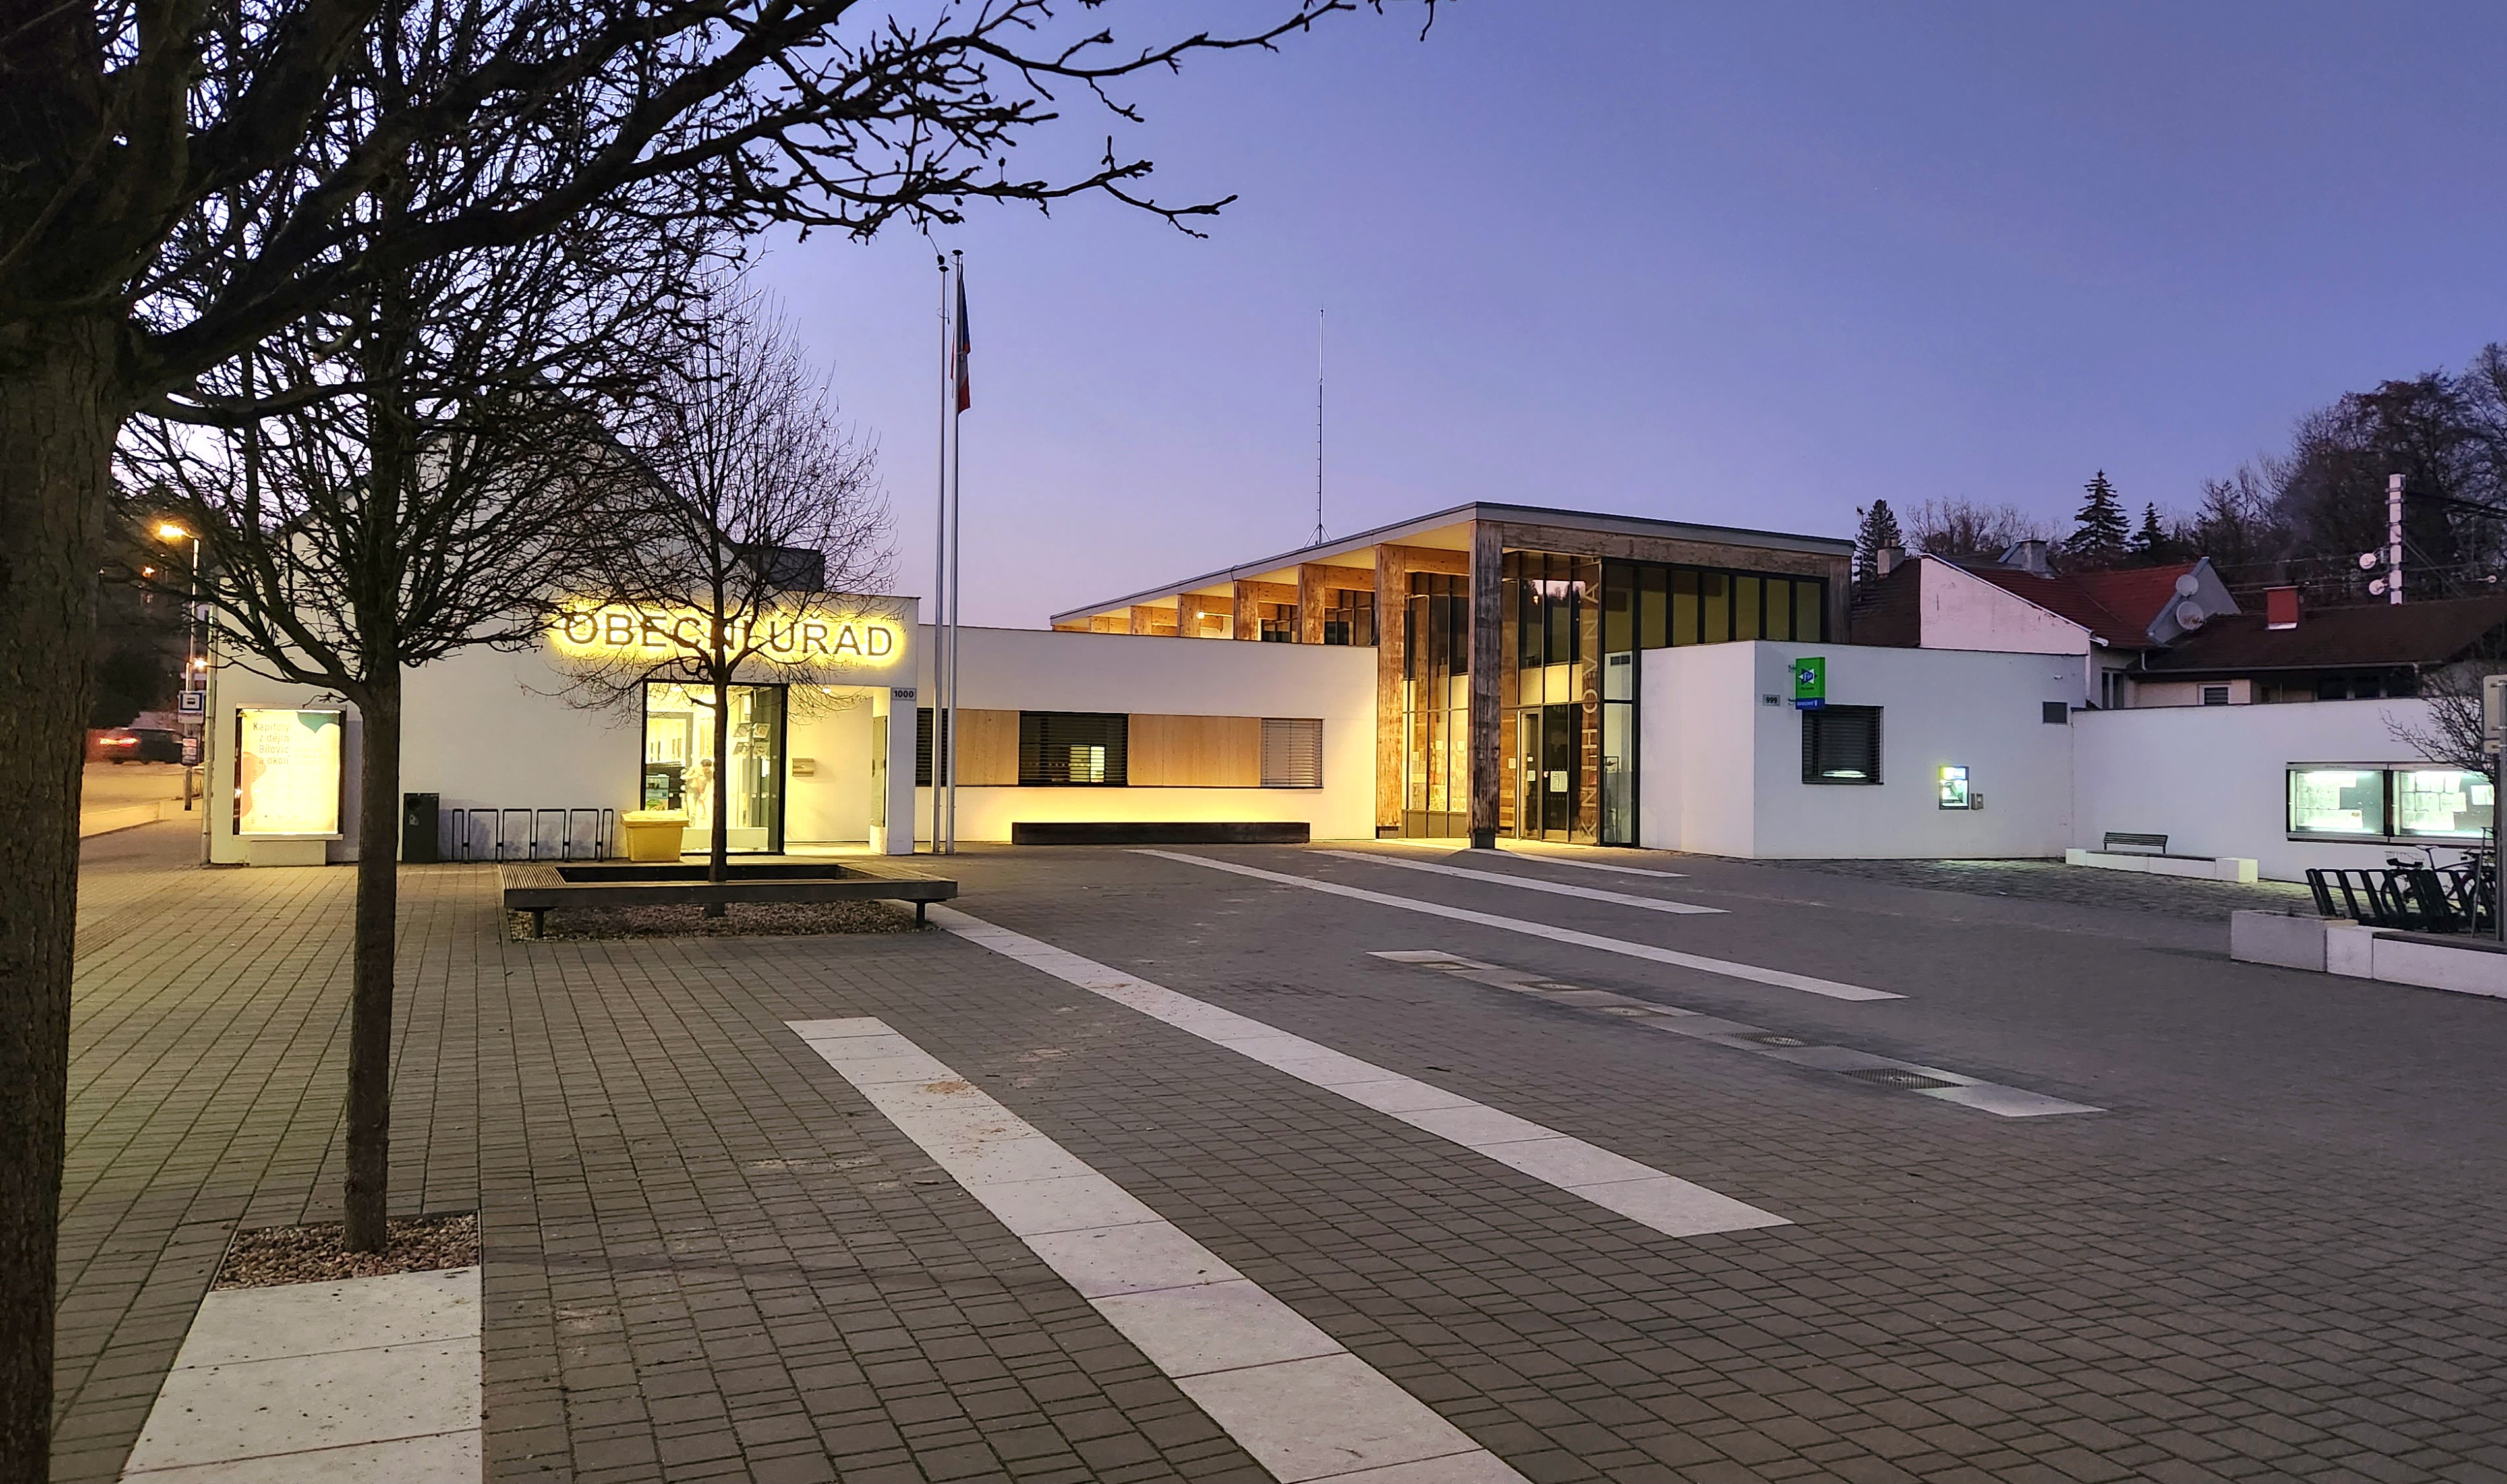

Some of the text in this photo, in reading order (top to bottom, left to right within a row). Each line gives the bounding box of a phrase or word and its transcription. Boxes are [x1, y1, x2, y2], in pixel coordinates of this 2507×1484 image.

[253, 722, 290, 733] Kapitoly
[266, 733, 289, 744] dějin
[259, 743, 289, 753] Bílovic
[267, 755, 289, 764] okolí
